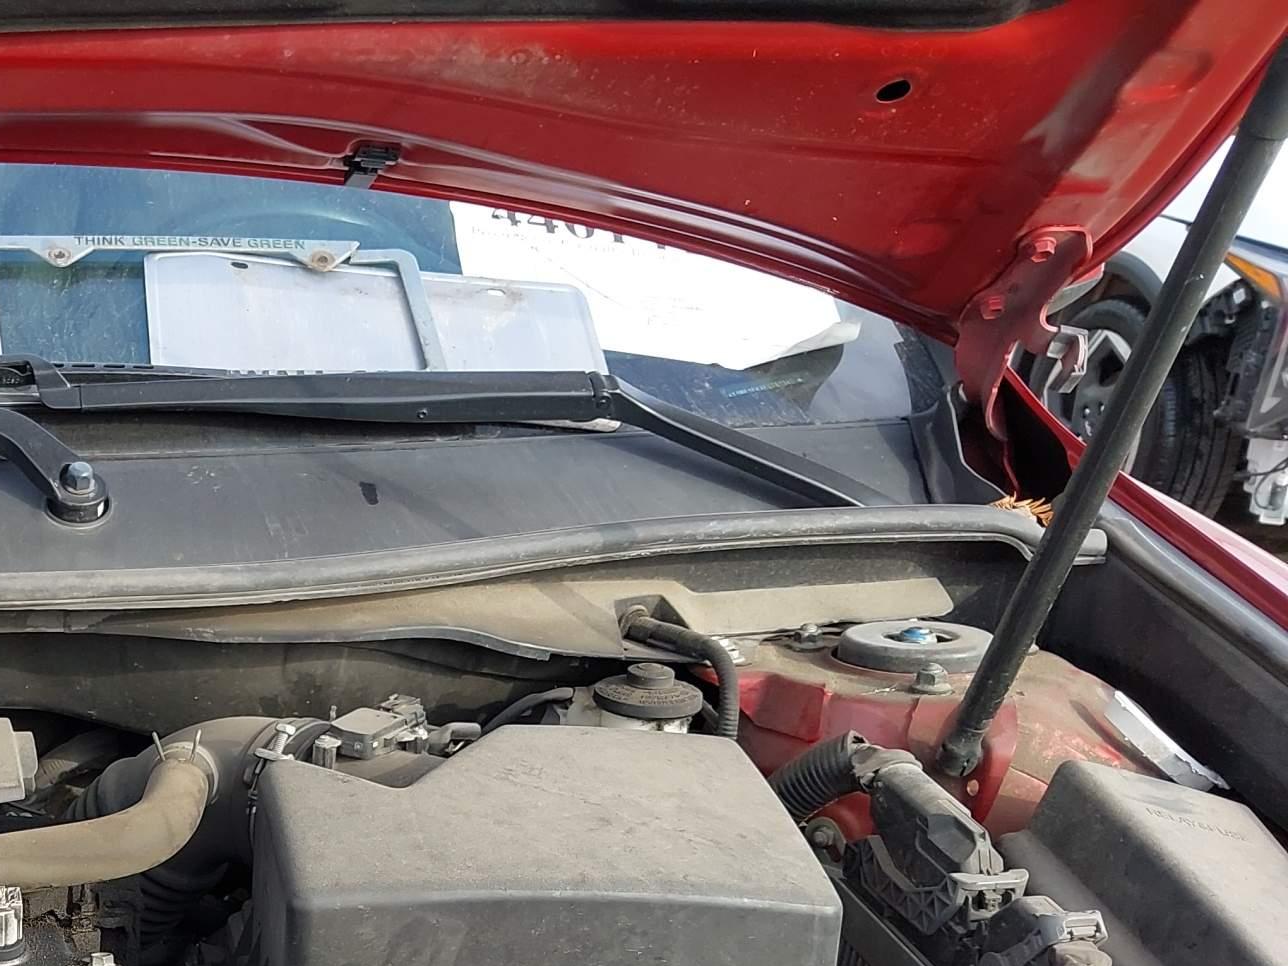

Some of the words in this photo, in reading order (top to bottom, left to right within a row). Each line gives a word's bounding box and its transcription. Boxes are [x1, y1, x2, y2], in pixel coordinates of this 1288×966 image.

[74, 236, 125, 247] THINK
[132, 237, 242, 248] GREEN-SAVE
[247, 239, 306, 250] GREEN
